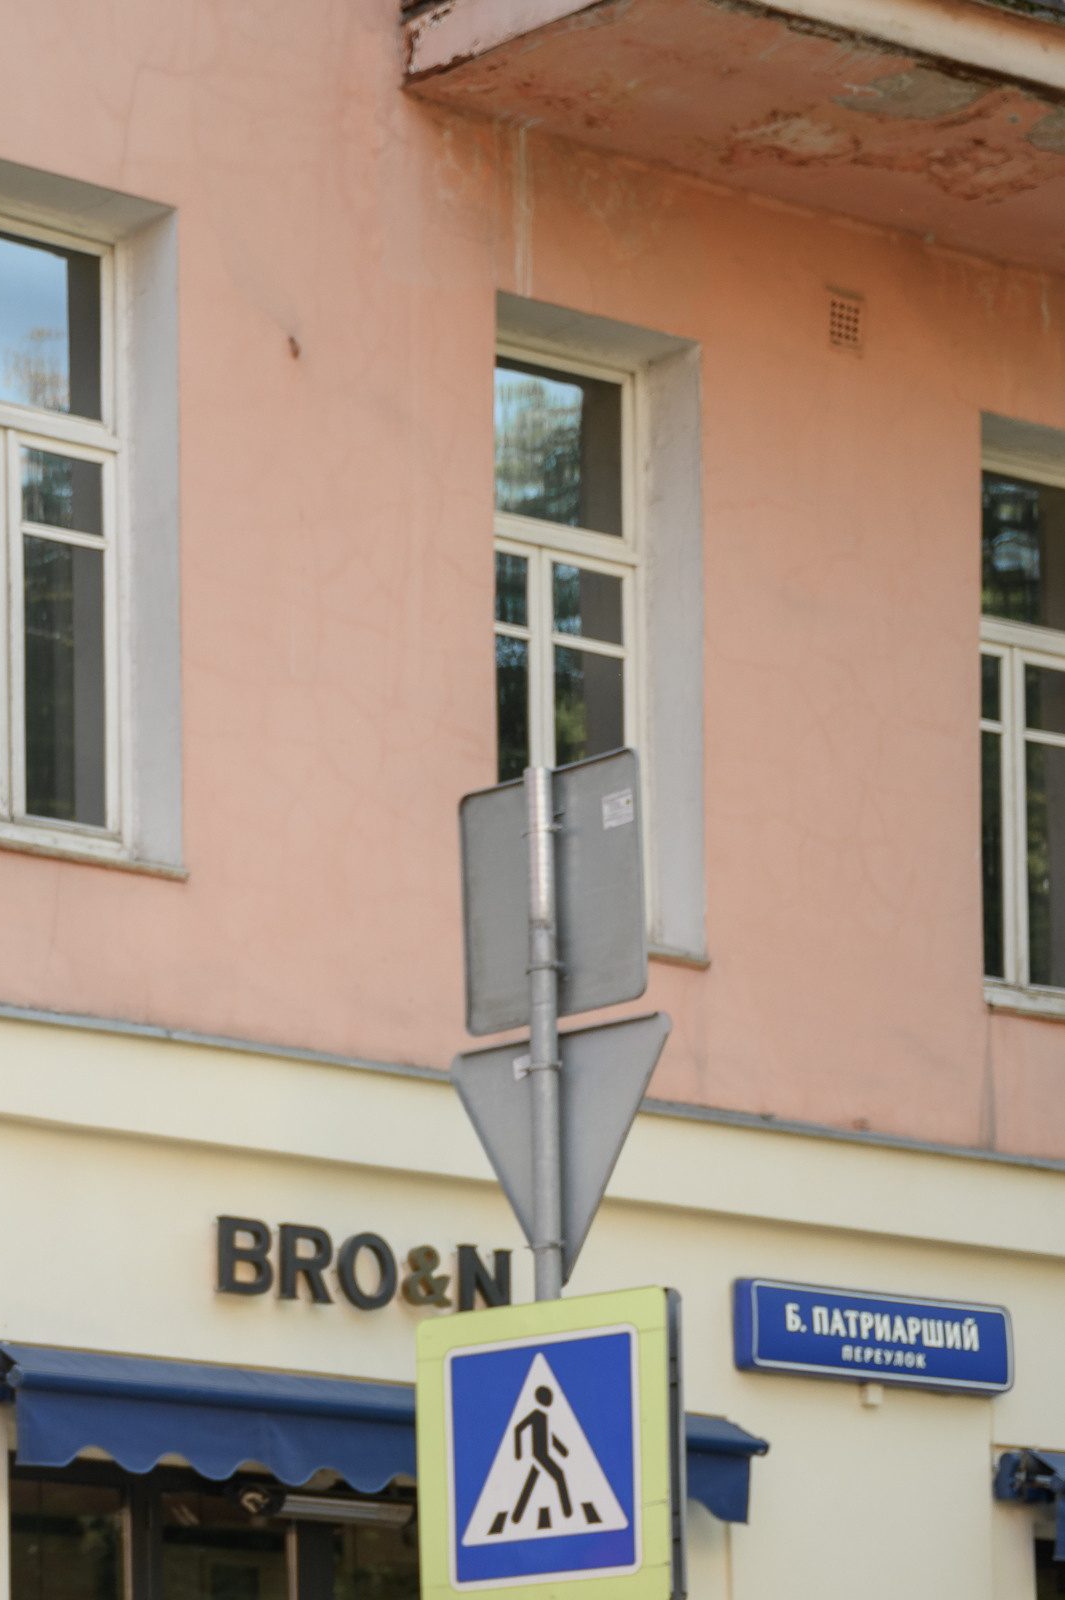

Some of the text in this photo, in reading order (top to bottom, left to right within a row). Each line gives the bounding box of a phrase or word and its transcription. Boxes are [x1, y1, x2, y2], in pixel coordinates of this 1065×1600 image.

[217, 1215, 512, 1311] BRO&N
[786, 1302, 980, 1352] Б. ПАТРИАРШИЙ
[841, 1344, 926, 1369] ПЕРЕУЛОК
